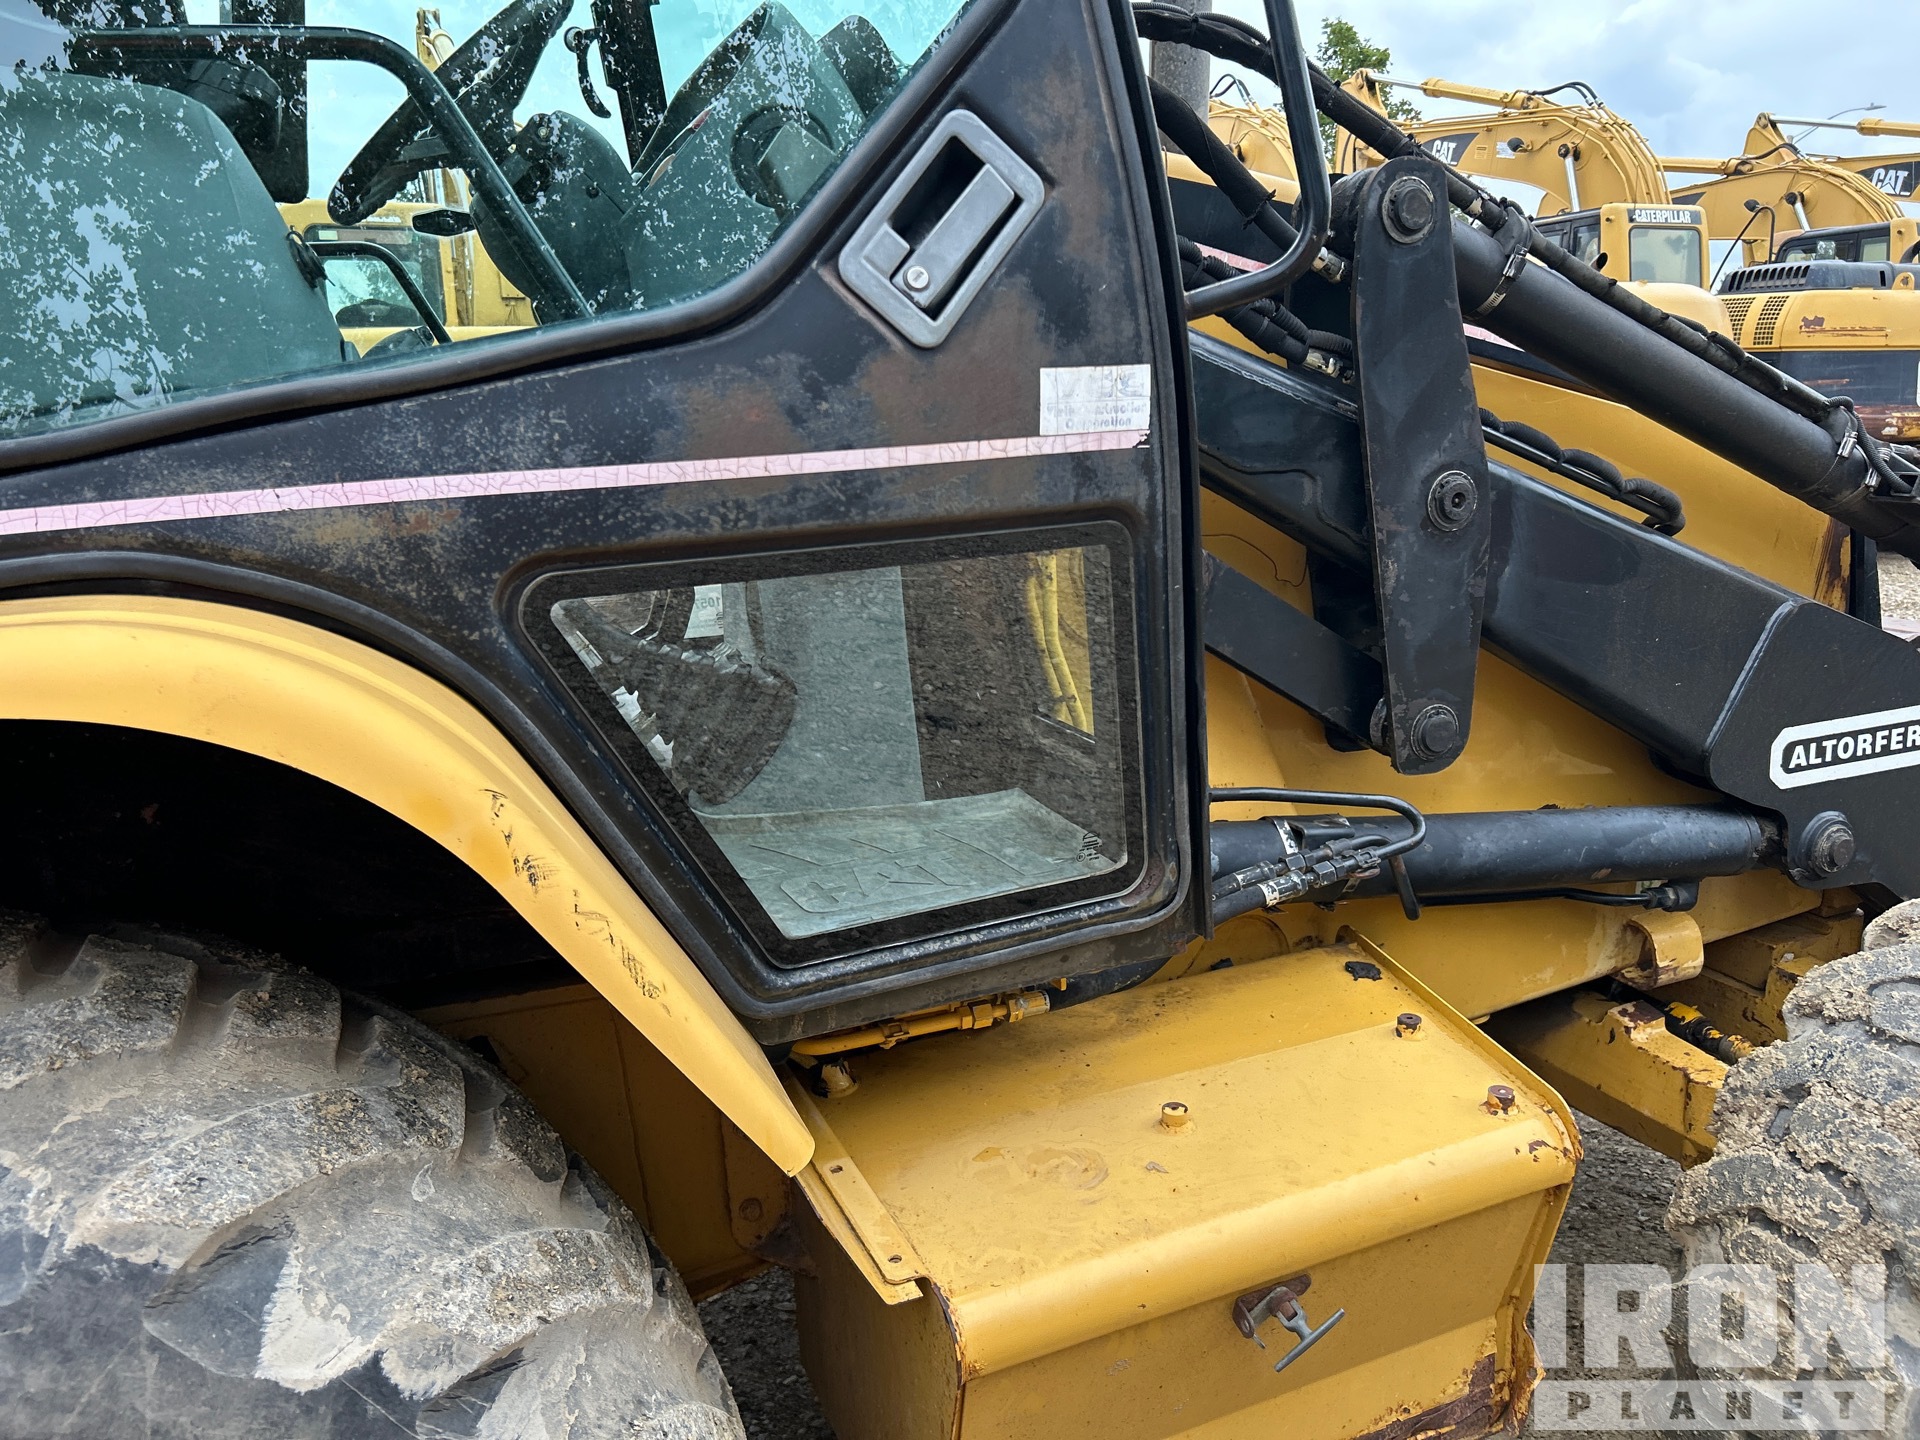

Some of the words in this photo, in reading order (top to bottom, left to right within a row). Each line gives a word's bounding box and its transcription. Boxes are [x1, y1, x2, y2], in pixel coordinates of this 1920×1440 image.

[1432, 139, 1458, 165] CAT
[1872, 168, 1910, 195] CAT
[1634, 209, 1691, 224] CATERPILLAR
[1788, 724, 1920, 769] ALTORFER
